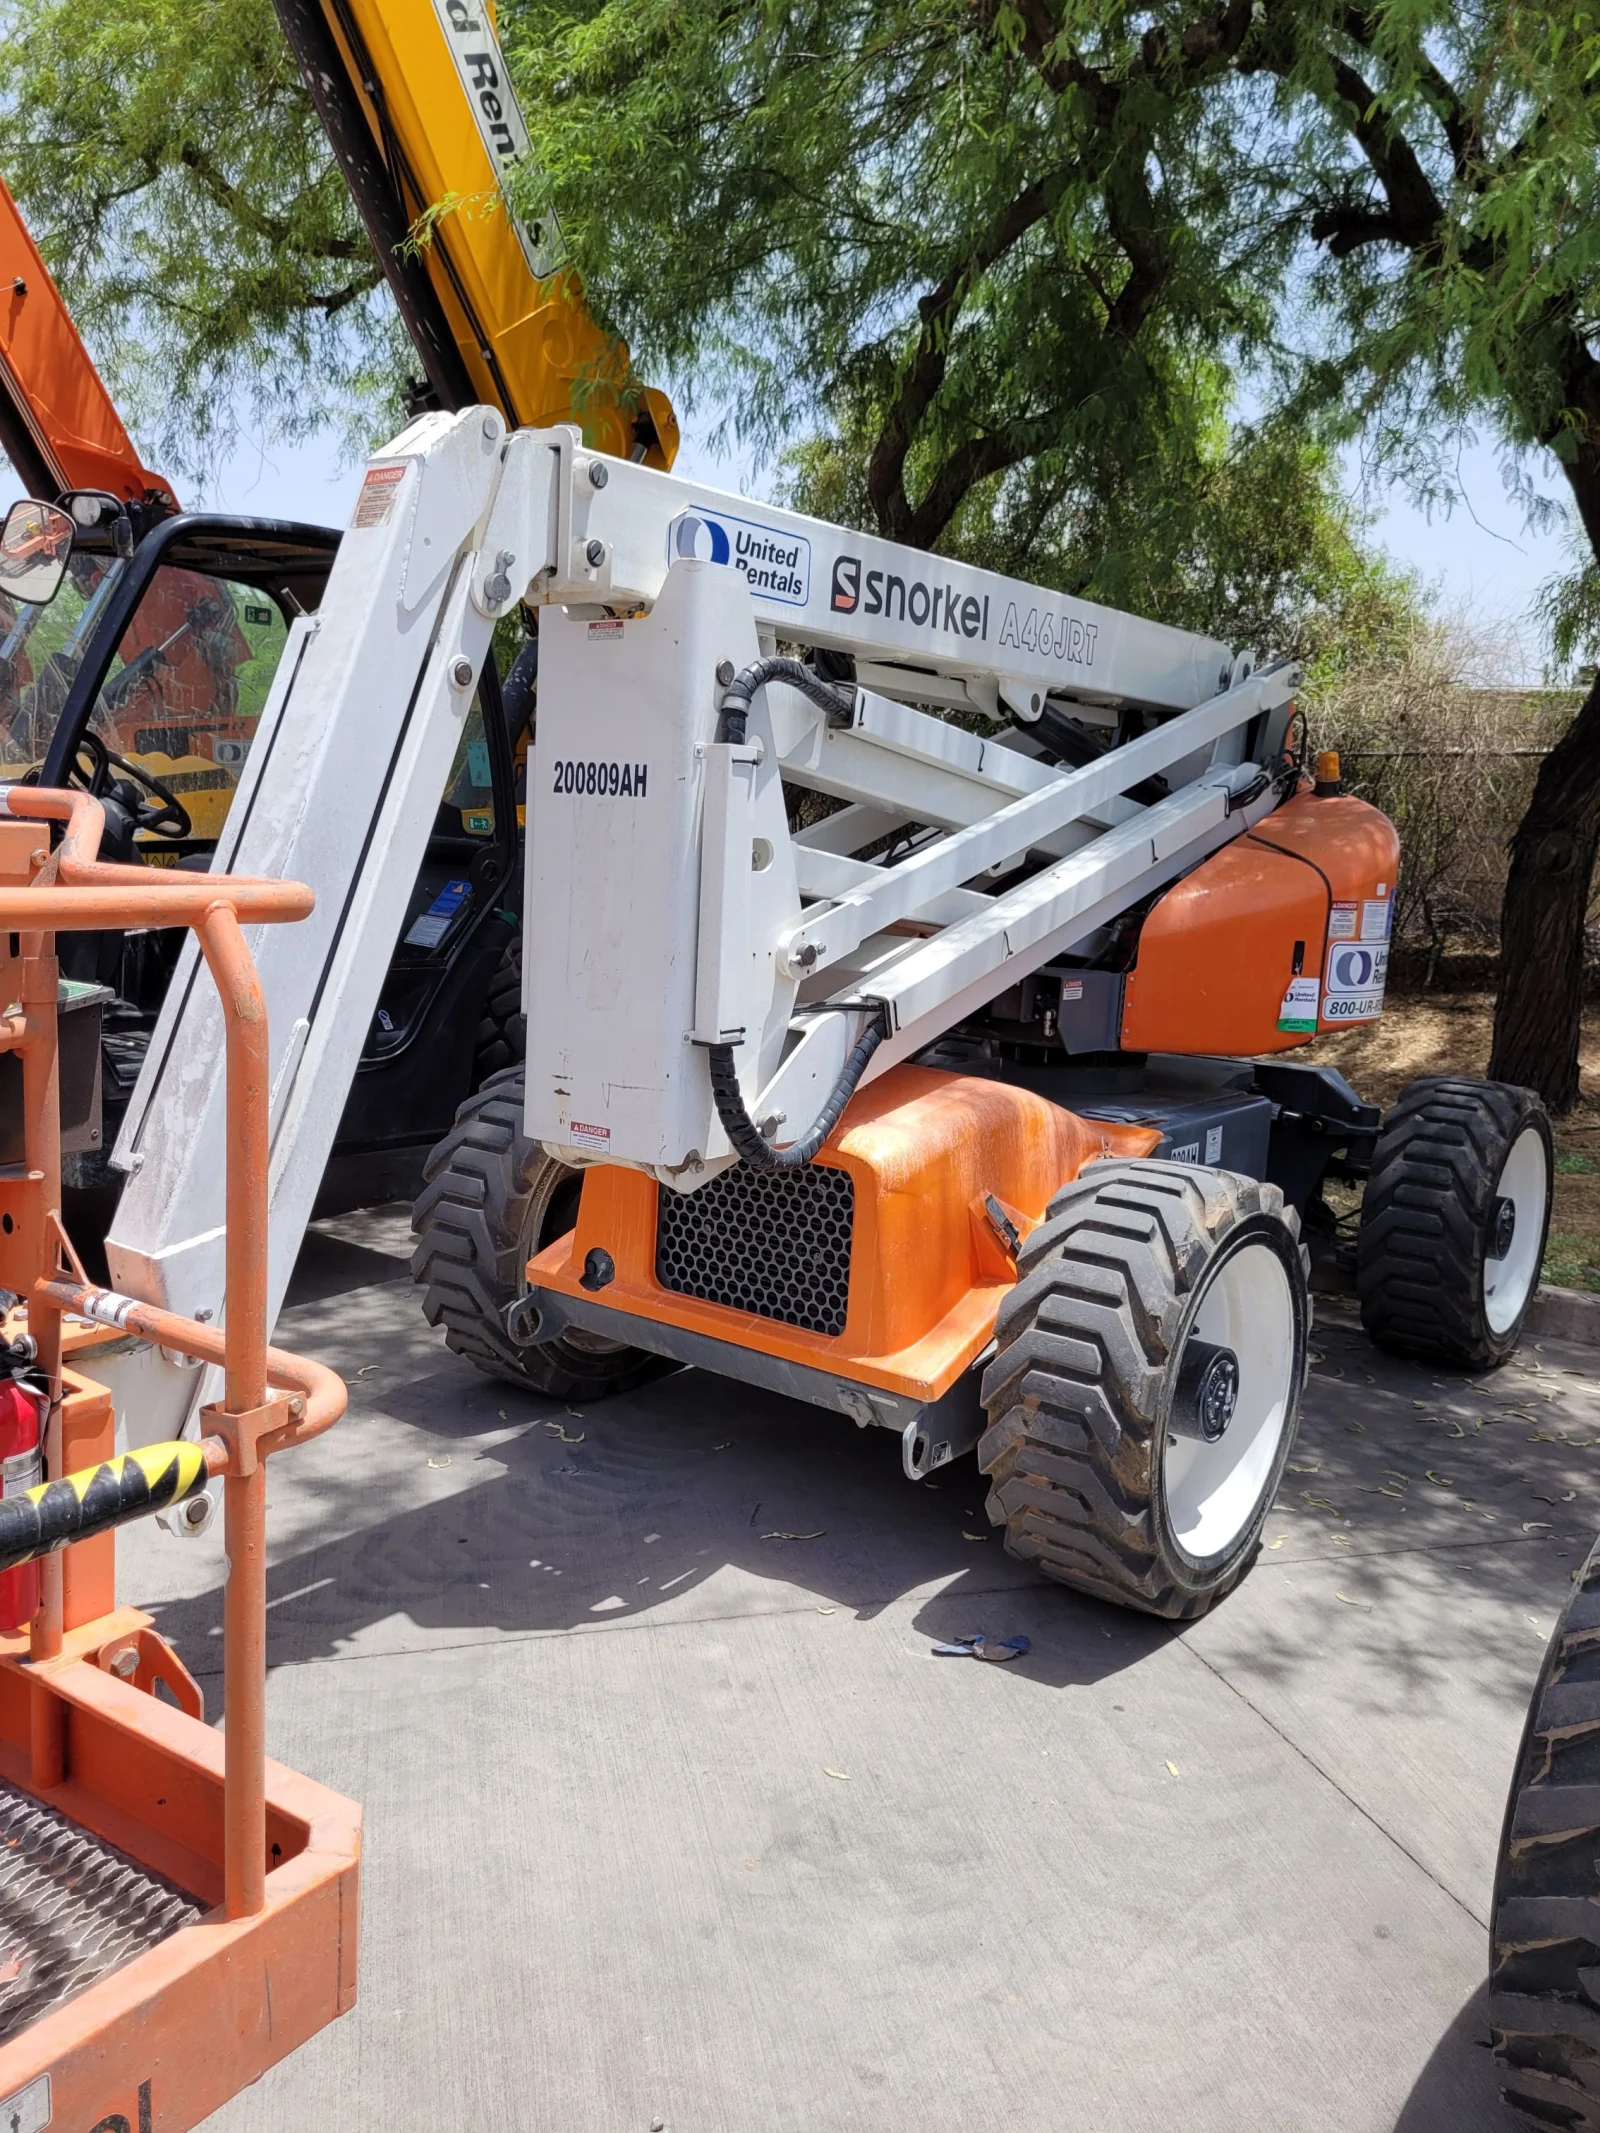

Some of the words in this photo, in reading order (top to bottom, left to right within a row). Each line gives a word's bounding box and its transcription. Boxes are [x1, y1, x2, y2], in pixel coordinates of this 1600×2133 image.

[464, 53, 548, 248] Rens
[371, 470, 403, 481] DANGER
[735, 531, 799, 569] United
[864, 570, 989, 641] snorkel
[998, 602, 1098, 666] A46JRT
[553, 761, 648, 798] 200809AH
[579, 1124, 607, 1137] DANGER
